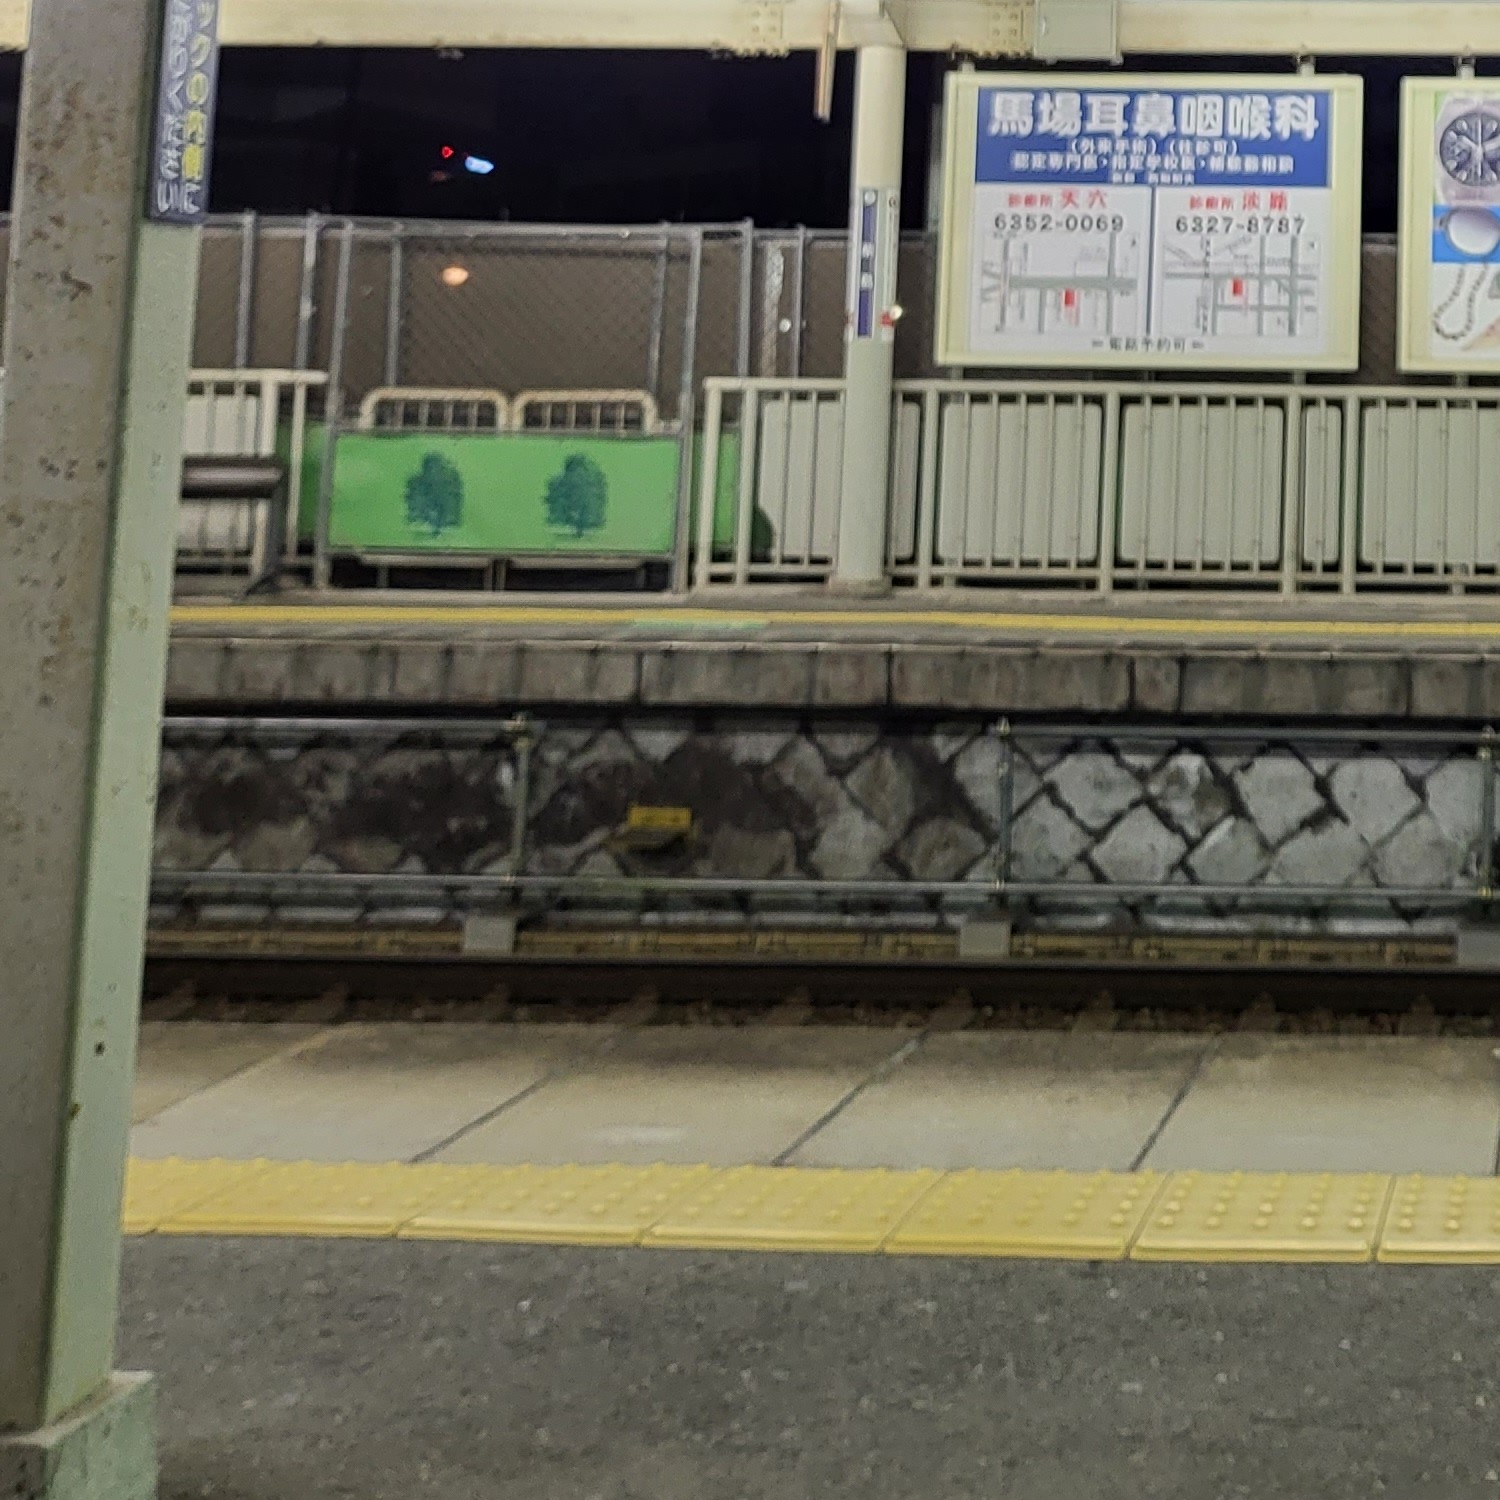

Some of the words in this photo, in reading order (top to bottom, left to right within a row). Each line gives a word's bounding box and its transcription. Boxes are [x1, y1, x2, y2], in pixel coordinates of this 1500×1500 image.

[990, 92, 1319, 139] 馬場耳鼻咽喉科
[994, 213, 1124, 232] 6352-0069
[1175, 214, 1305, 234] 6327-8787
